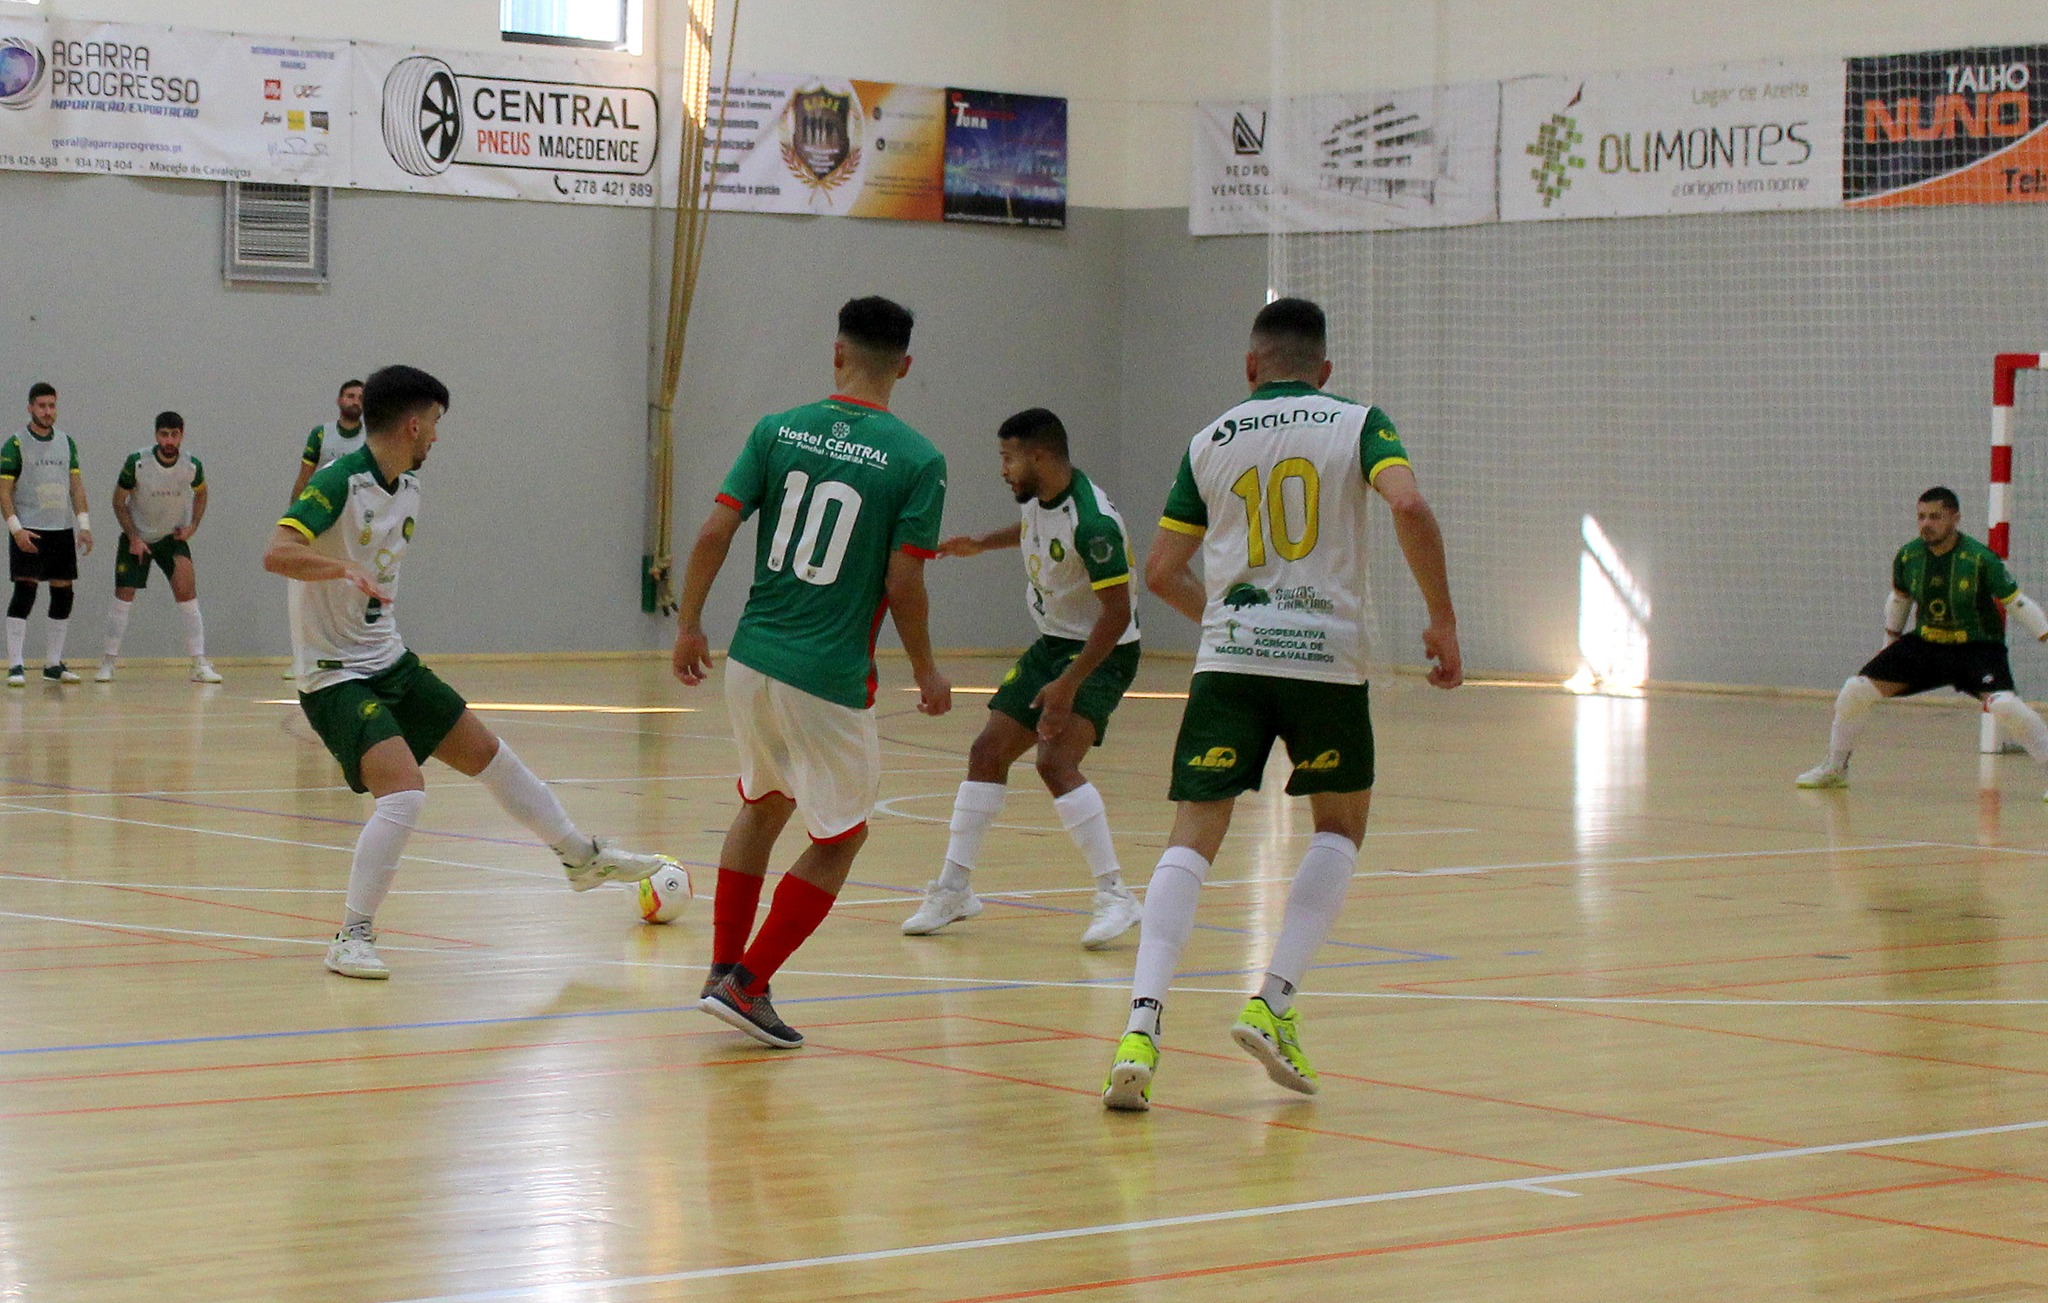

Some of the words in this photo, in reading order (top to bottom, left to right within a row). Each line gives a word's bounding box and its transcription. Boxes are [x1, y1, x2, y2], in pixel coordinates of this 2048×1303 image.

[52, 40, 149, 71] AGARRA
[52, 70, 200, 104] PROGRESSO
[1946, 62, 2030, 93] TALHO
[473, 87, 640, 131] CENTRAL
[1863, 90, 2030, 144] NUNO
[477, 129, 530, 156] PNEUS
[539, 135, 639, 163] MACEDENCE
[1226, 165, 1269, 176] PEDRO
[574, 179, 598, 195] 278
[602, 182, 624, 196] 421
[629, 184, 653, 198] 889
[778, 425, 823, 447] Hostel
[825, 438, 888, 466] CENTRAL
[796, 441, 825, 456] Funchal
[829, 451, 864, 465] MADEIRA
[1230, 456, 1320, 568] 10
[766, 470, 863, 586] 10
[1253, 627, 1327, 640] COOPERATIVA
[1254, 637, 1307, 651] AGRÍCOLA
[1309, 641, 1324, 651] DE
[1255, 649, 1270, 658] DE
[1272, 650, 1335, 664] CAVALEIROS
